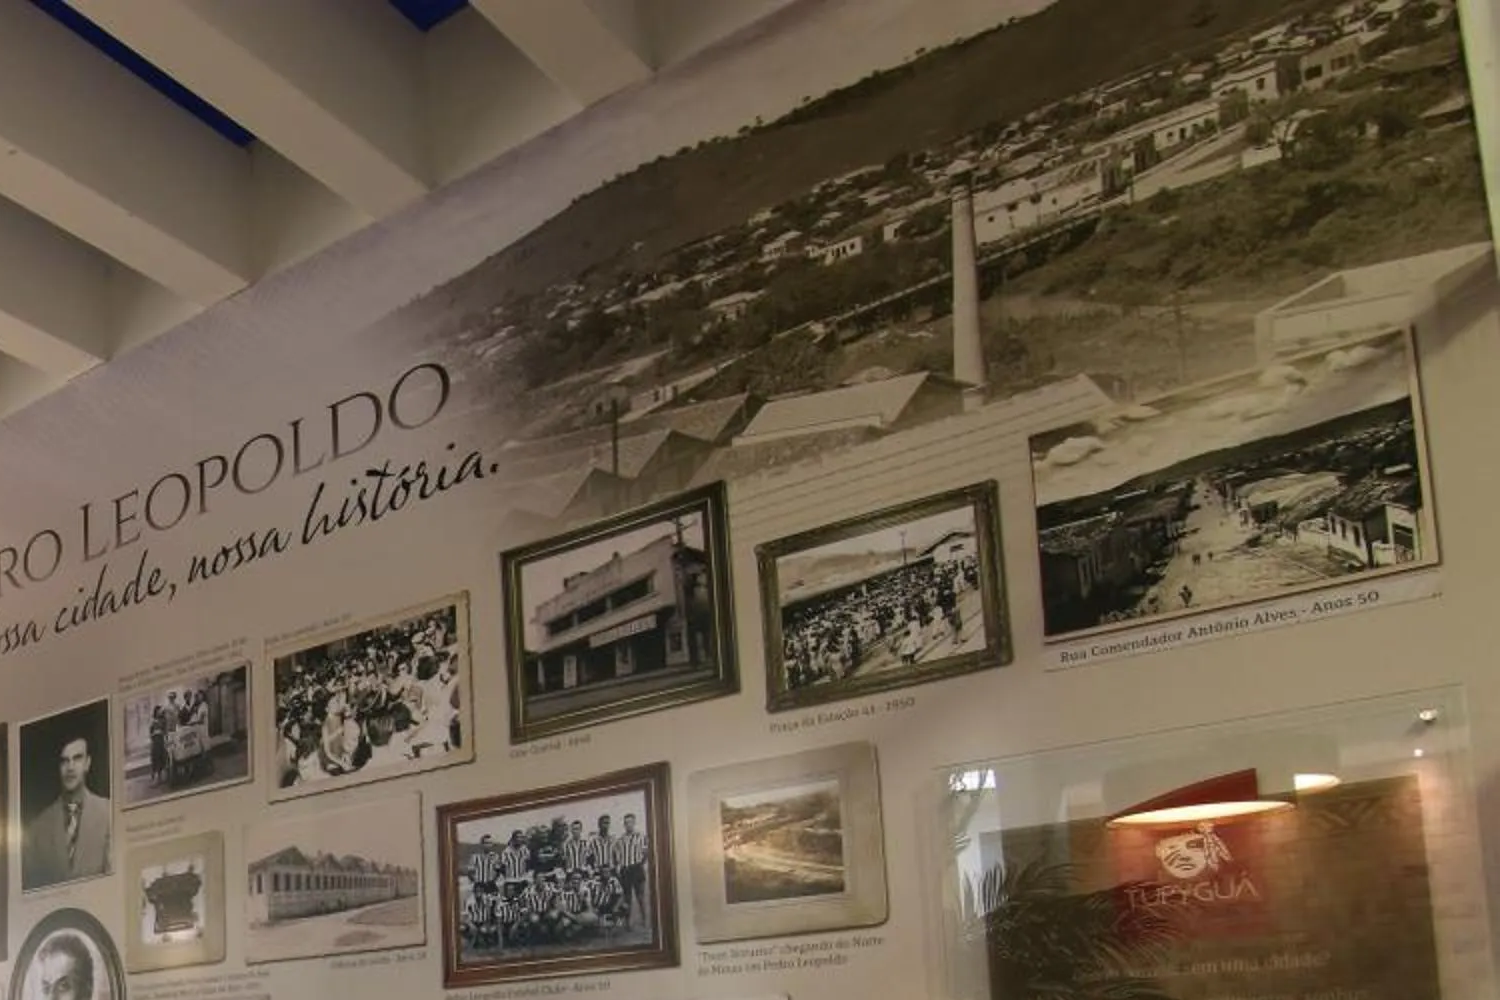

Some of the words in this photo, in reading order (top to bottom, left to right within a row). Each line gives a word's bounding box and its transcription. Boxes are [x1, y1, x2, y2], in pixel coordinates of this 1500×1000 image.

[54, 548, 178, 636] cidade,
[186, 527, 293, 582] nossa
[300, 443, 500, 545] história.
[80, 362, 451, 563] LEOPOLDO
[1059, 648, 1088, 664] Rua
[1090, 631, 1184, 658] Comendador
[1254, 607, 1298, 629] Alves
[1311, 598, 1354, 615] Anos
